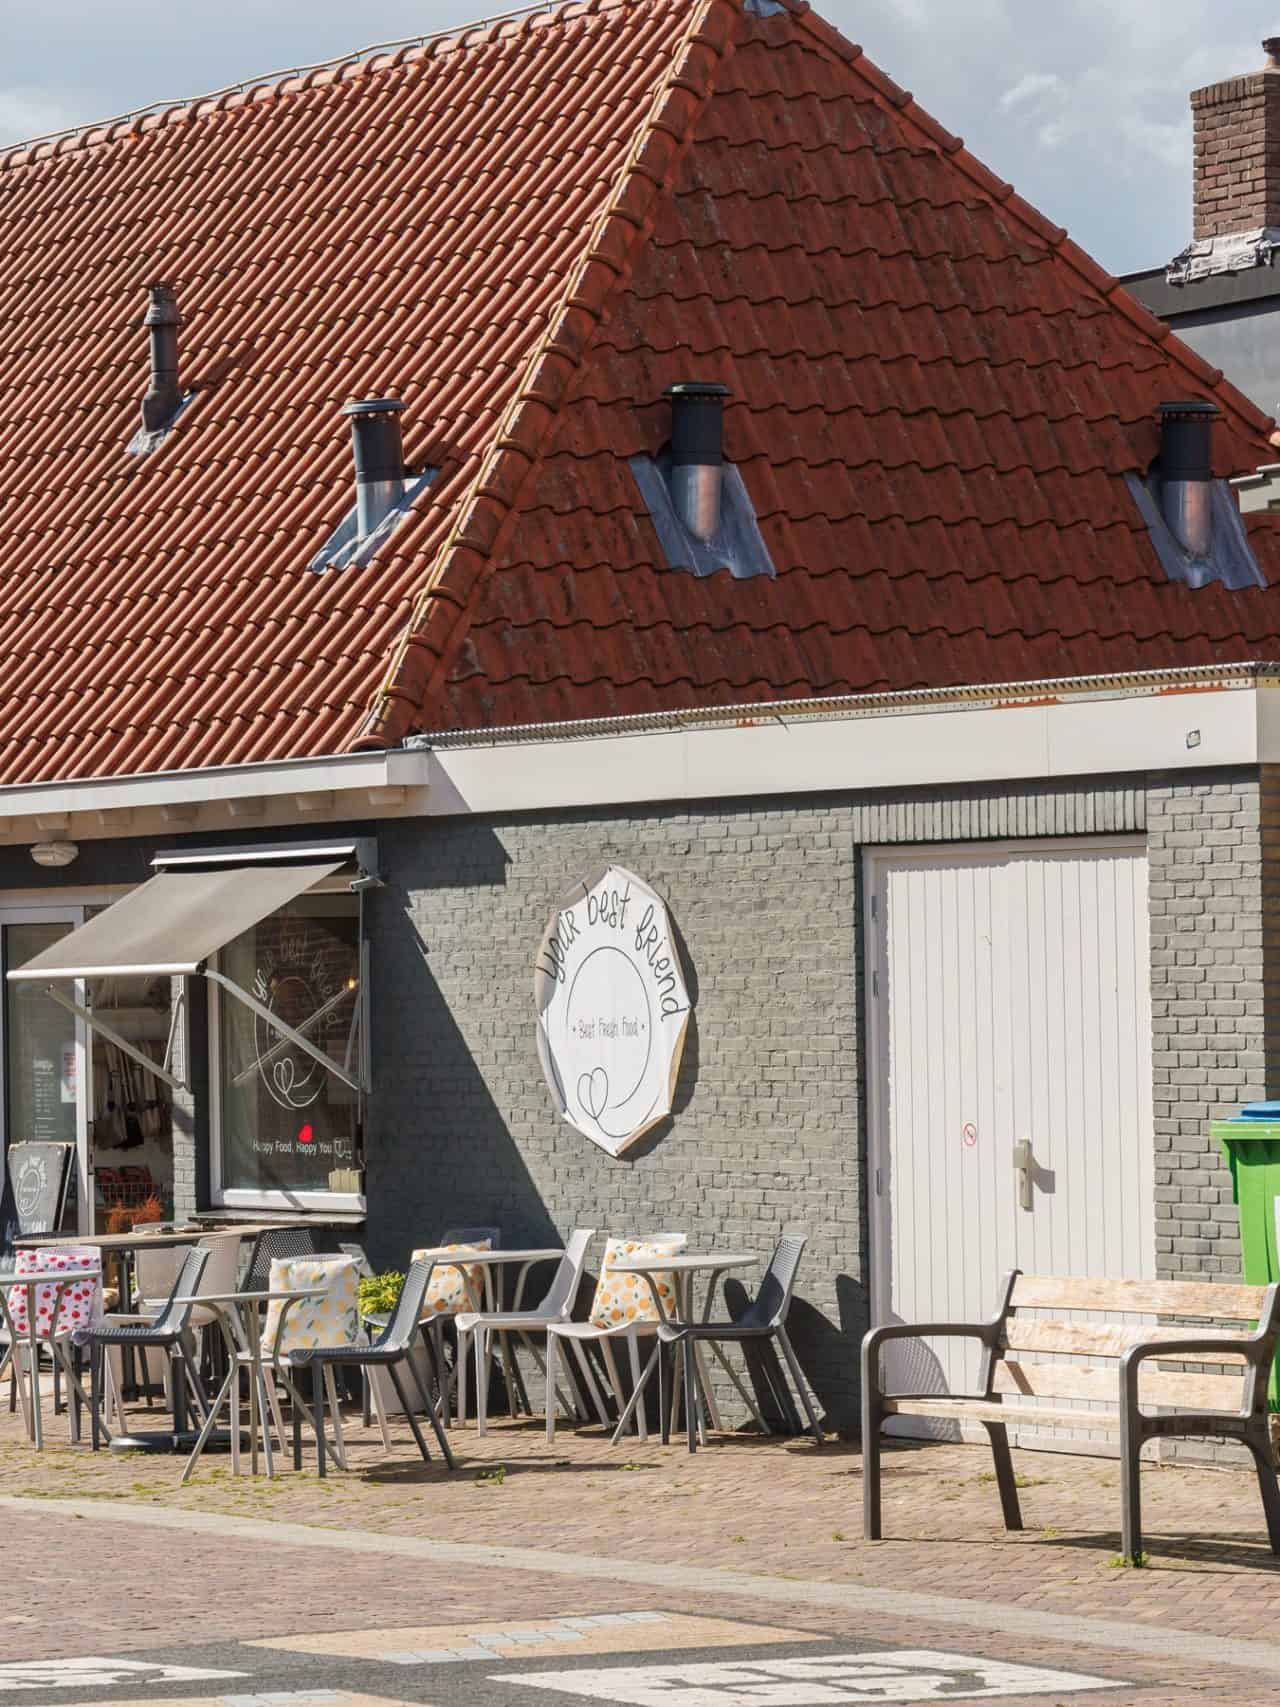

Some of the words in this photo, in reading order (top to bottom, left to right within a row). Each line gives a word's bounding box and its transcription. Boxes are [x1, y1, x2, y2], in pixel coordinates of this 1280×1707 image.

[582, 881, 631, 930] best
[295, 1142, 317, 1157] Happy
[319, 1143, 333, 1153] You
